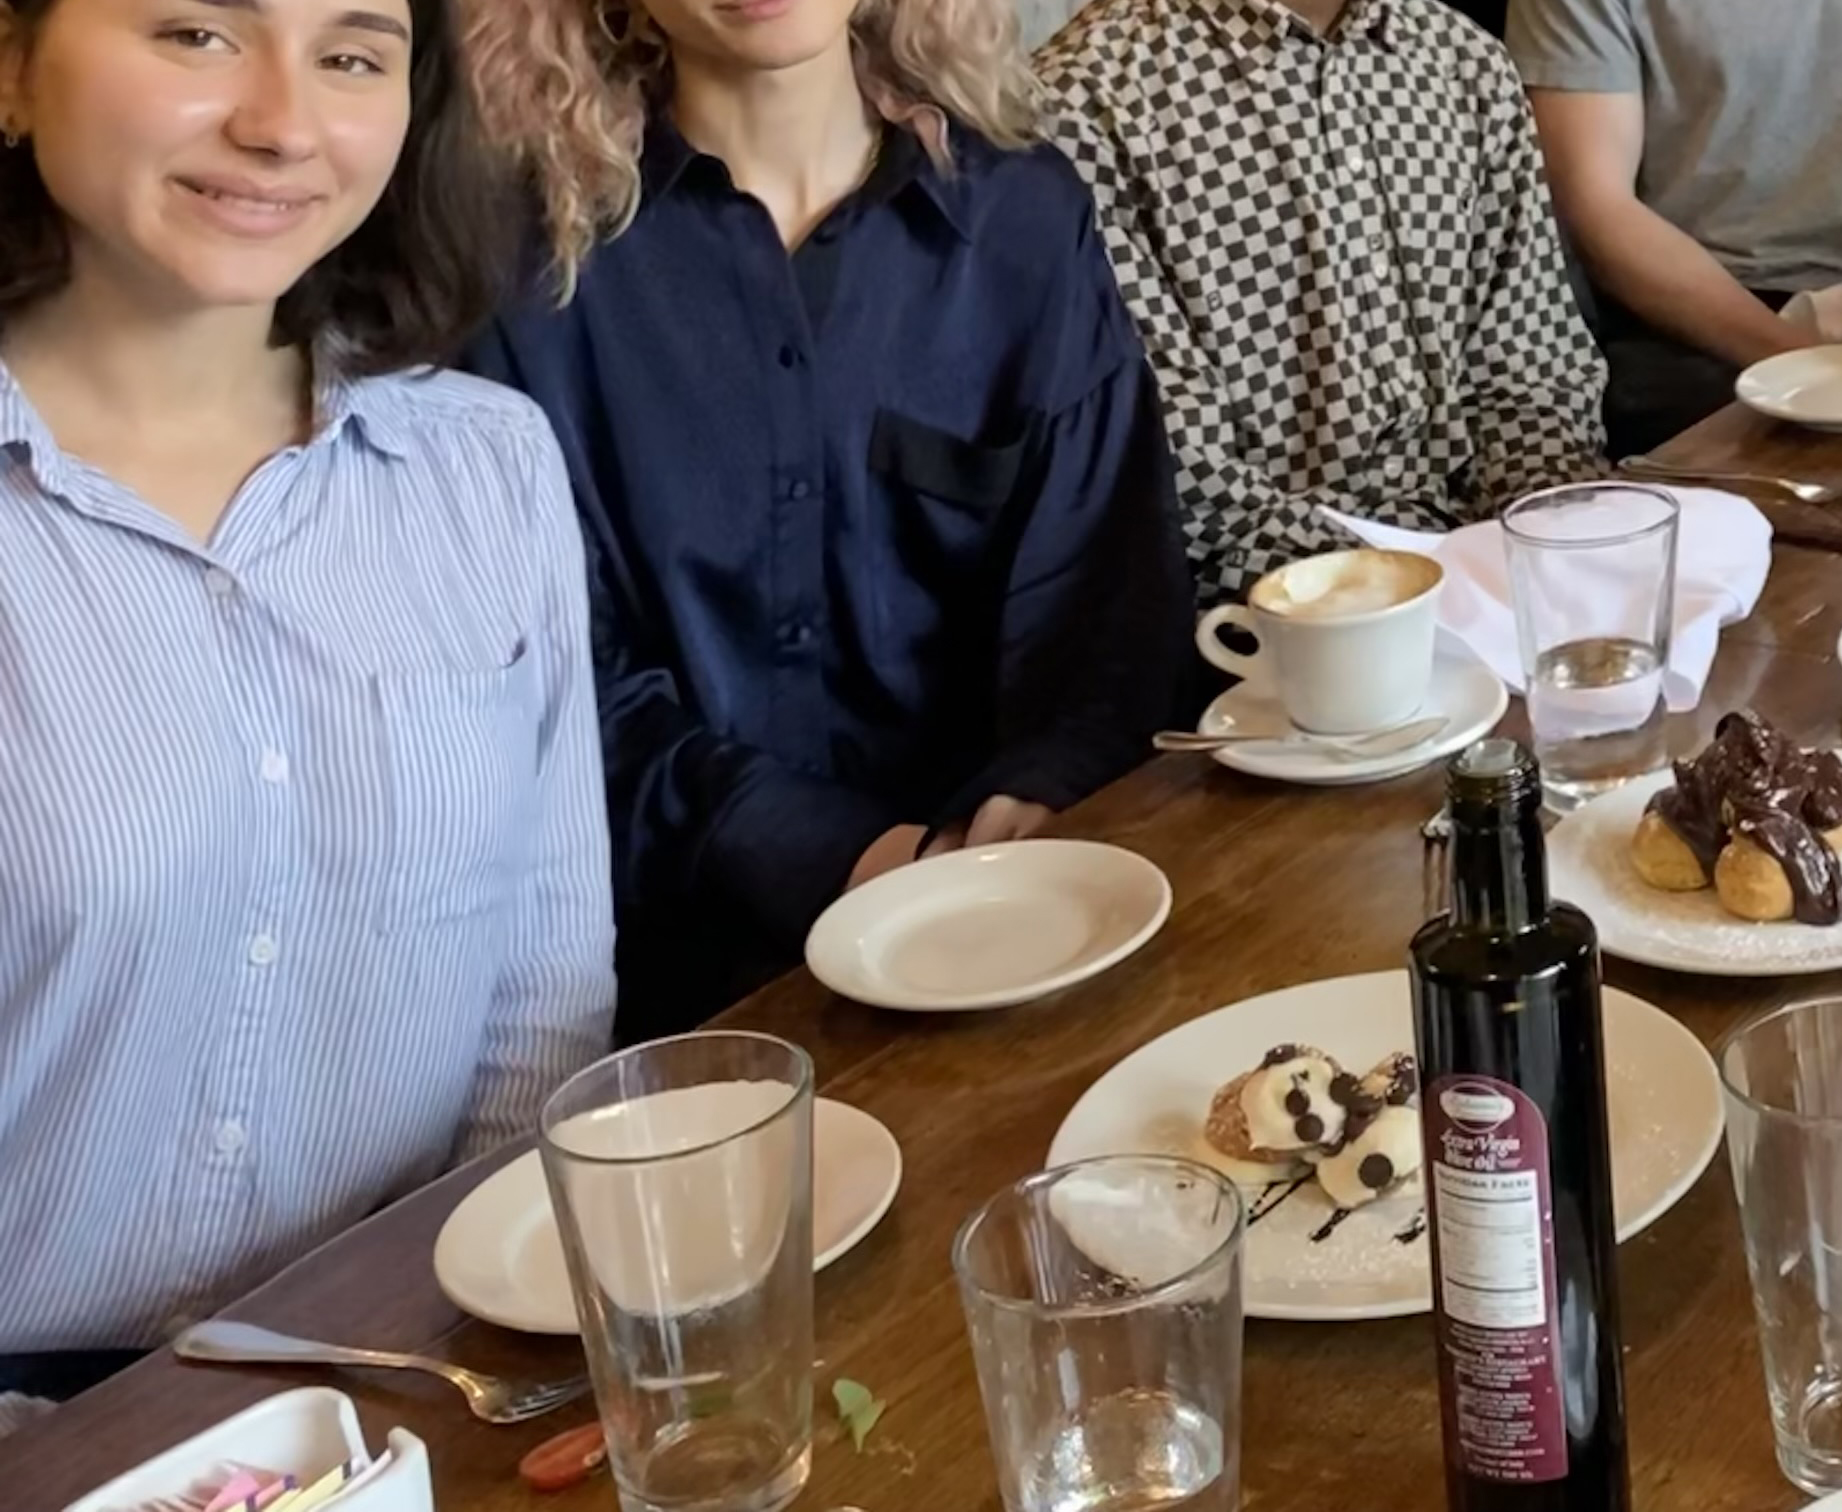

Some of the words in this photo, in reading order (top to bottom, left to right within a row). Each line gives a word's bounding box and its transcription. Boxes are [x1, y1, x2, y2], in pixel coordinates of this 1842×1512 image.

[1474, 1133, 1520, 1159] Virgin
[1474, 1153, 1497, 1171] Oil
[1439, 1169, 1487, 1188] rition
